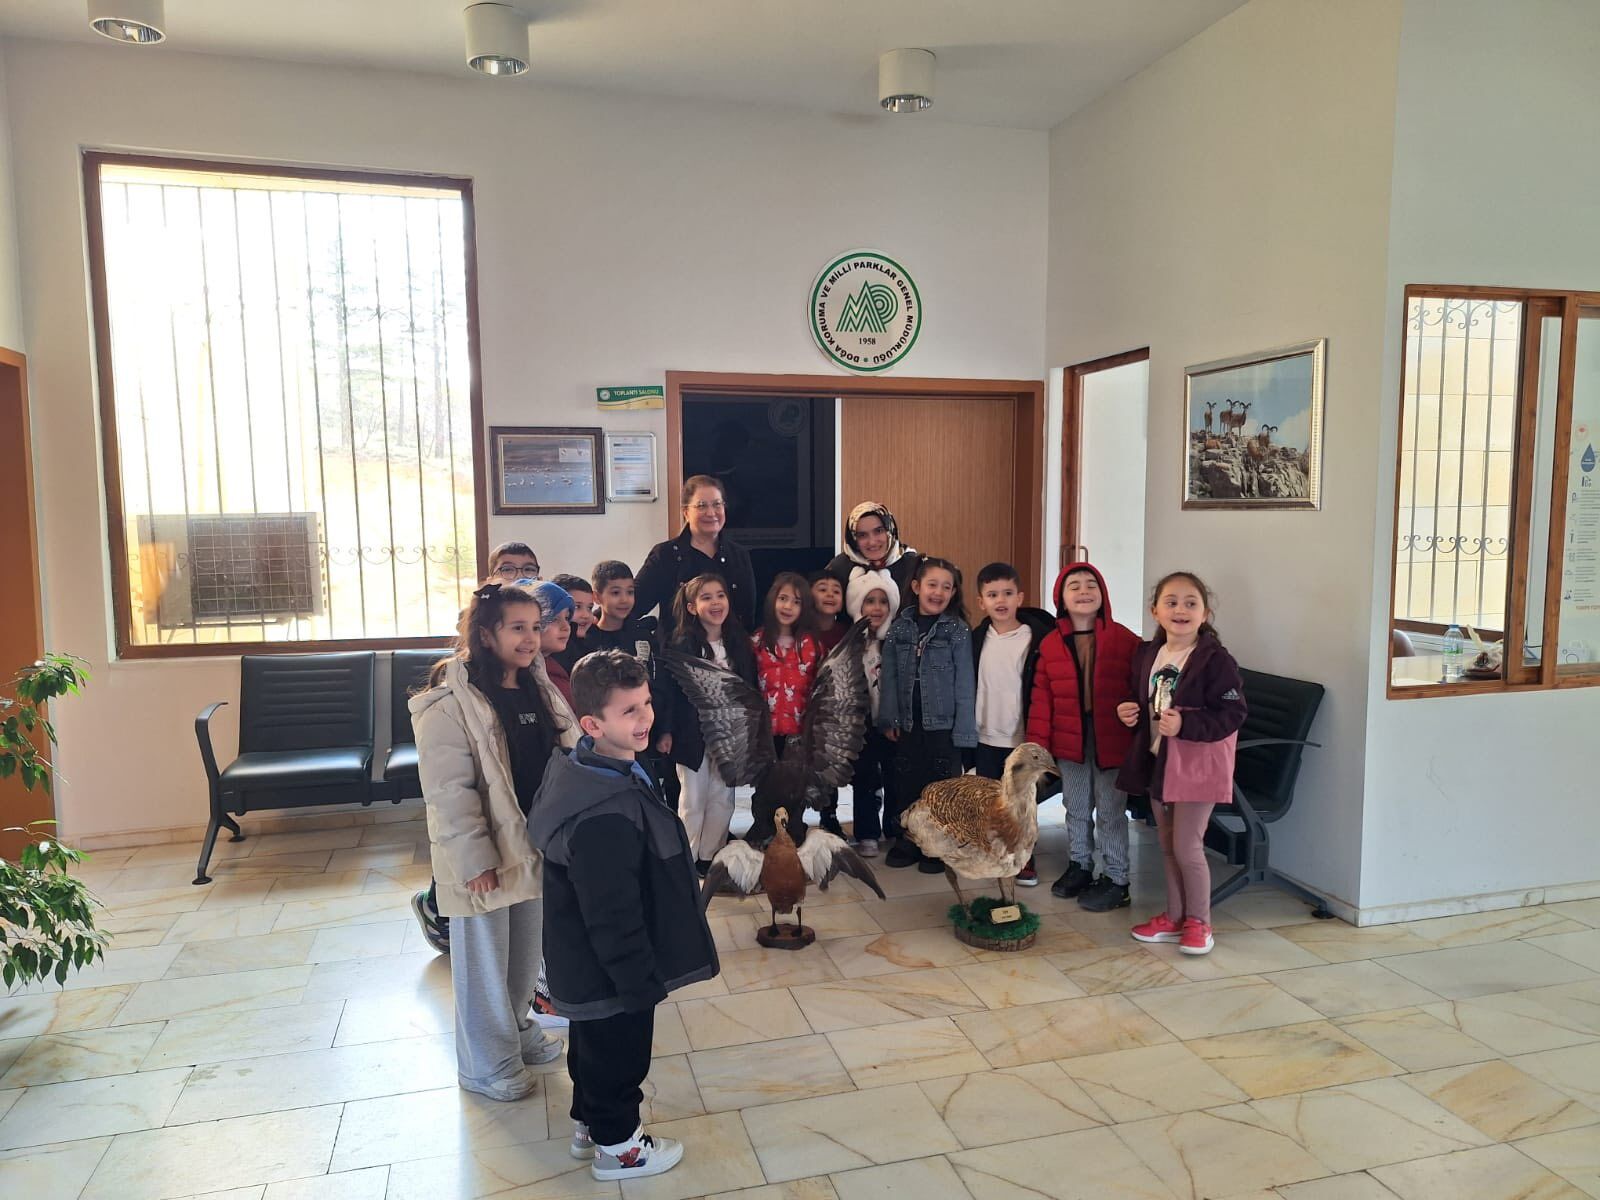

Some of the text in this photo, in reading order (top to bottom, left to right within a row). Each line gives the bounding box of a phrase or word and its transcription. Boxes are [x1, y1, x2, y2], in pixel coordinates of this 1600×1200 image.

[818, 261, 914, 364] DOĞA KORUMA VE MİLLİ PARKLAR GENEL MÜDÜRLÜĞÜ
[858, 337, 876, 345] 1958
